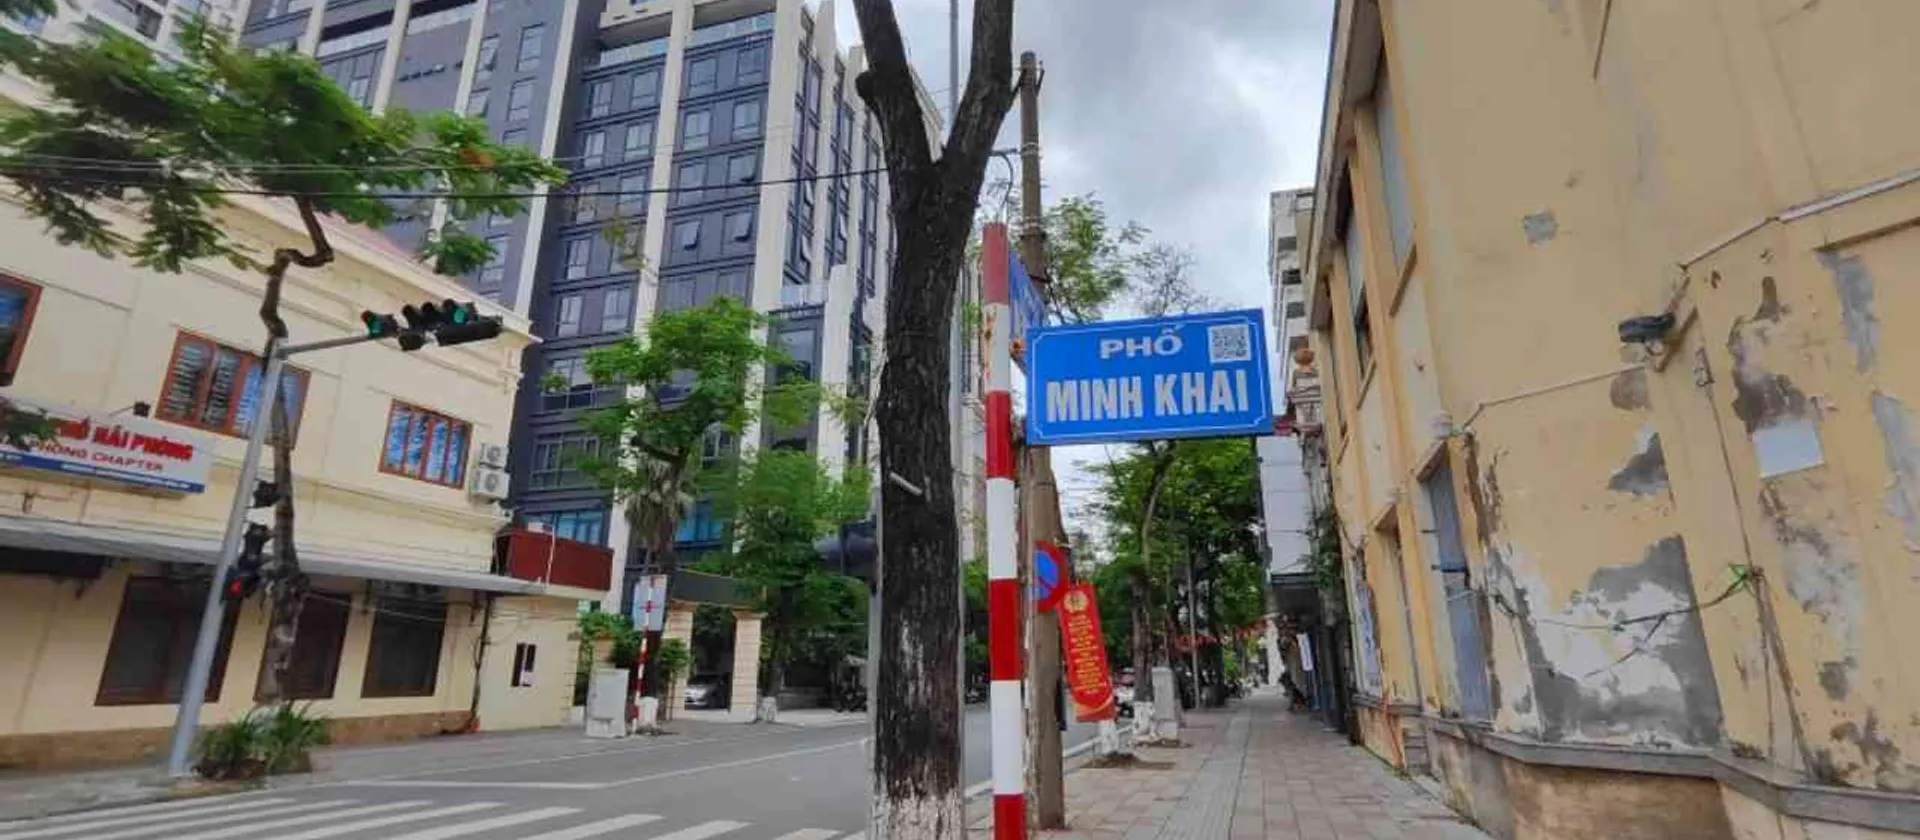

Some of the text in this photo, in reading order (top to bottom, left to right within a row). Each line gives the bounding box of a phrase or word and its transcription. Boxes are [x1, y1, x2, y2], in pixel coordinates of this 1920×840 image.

[1100, 324, 1184, 360] PHỐ
[1046, 369, 1249, 423] MINH KHAI
[91, 451, 165, 472] CHAPTER
